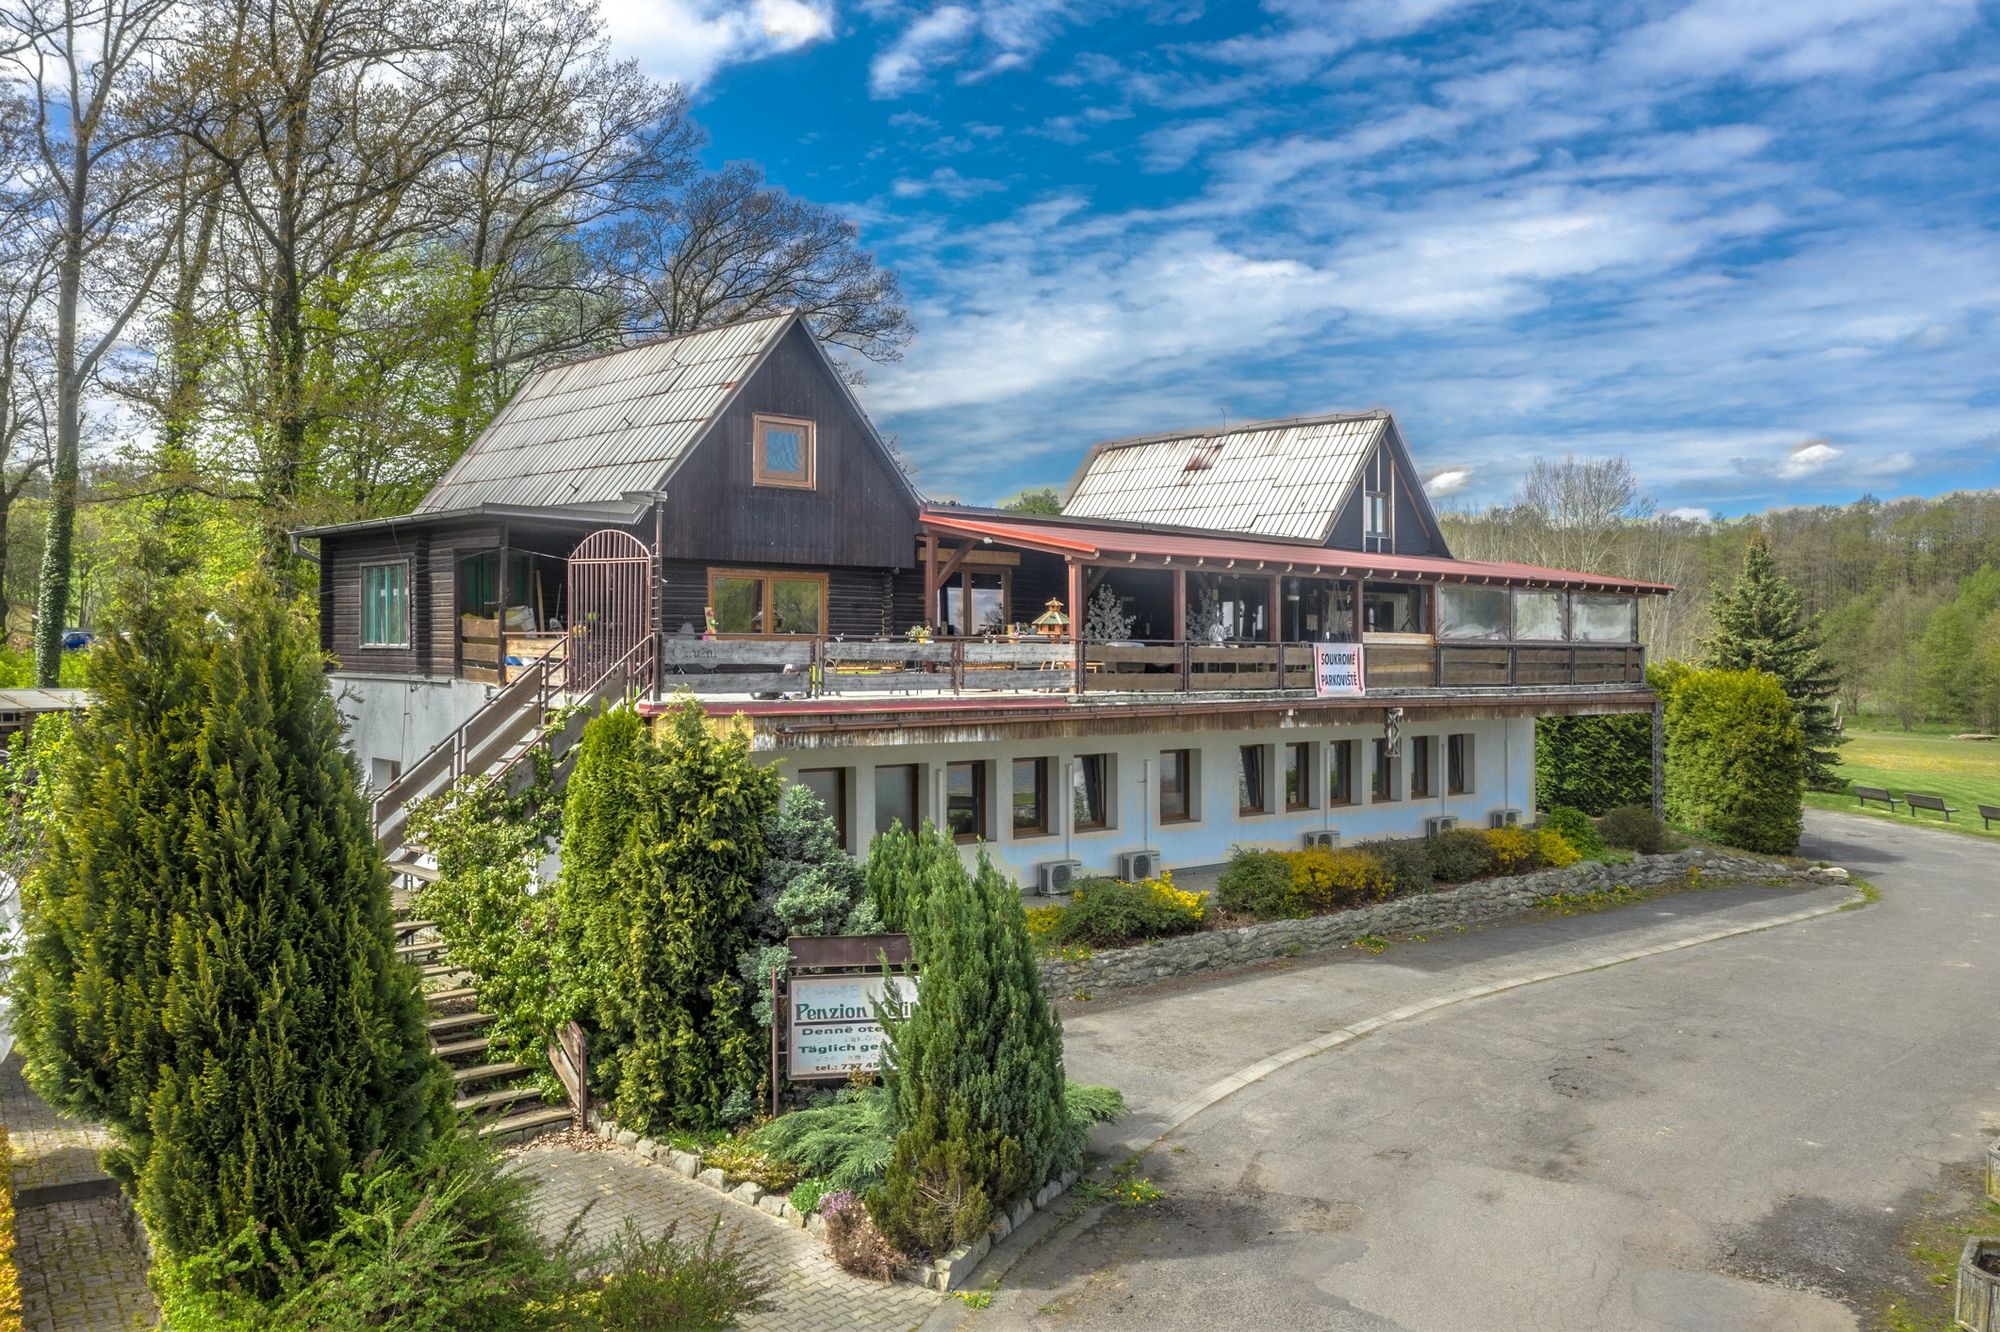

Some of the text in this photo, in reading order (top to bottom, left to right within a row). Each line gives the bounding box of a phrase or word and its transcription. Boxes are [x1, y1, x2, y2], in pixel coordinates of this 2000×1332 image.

[1321, 650, 1355, 665] SOUKROMÉ
[1321, 671, 1358, 686] PARKOVIŠTĚ
[796, 1003, 868, 1021] Penzion
[802, 1026, 853, 1036] Denně
[798, 1044, 879, 1054] Täglich ge
